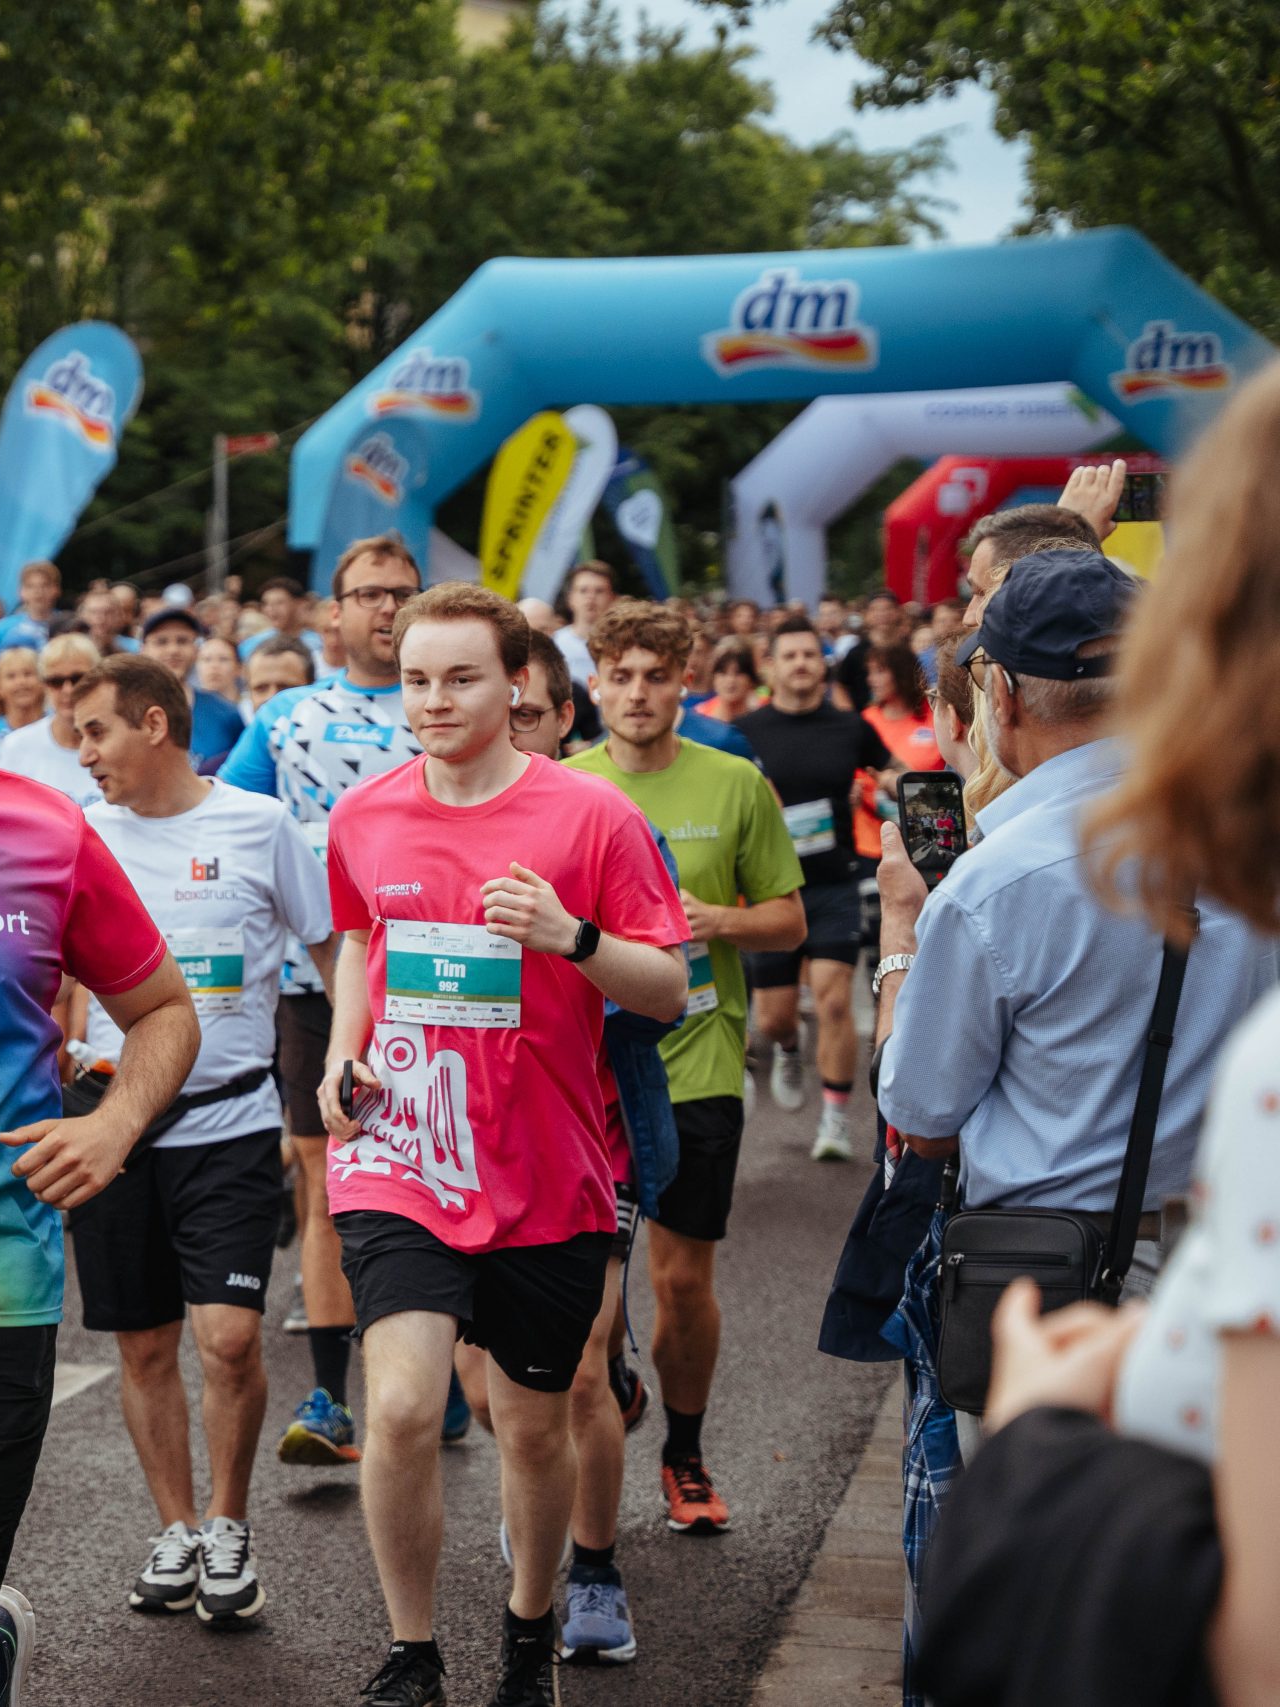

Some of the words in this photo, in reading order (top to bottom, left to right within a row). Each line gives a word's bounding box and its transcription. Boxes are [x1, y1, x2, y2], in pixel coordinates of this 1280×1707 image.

[740, 273, 849, 331] dm
[1133, 326, 1217, 373] dm
[48, 355, 115, 420] dm
[392, 356, 465, 391] dm
[362, 434, 403, 478] dm
[489, 430, 560, 581] SPRINTER
[174, 886, 239, 901] boxdruck
[433, 958, 466, 979] Tim
[438, 980, 459, 992] 992
[225, 1272, 261, 1290] JAKO
